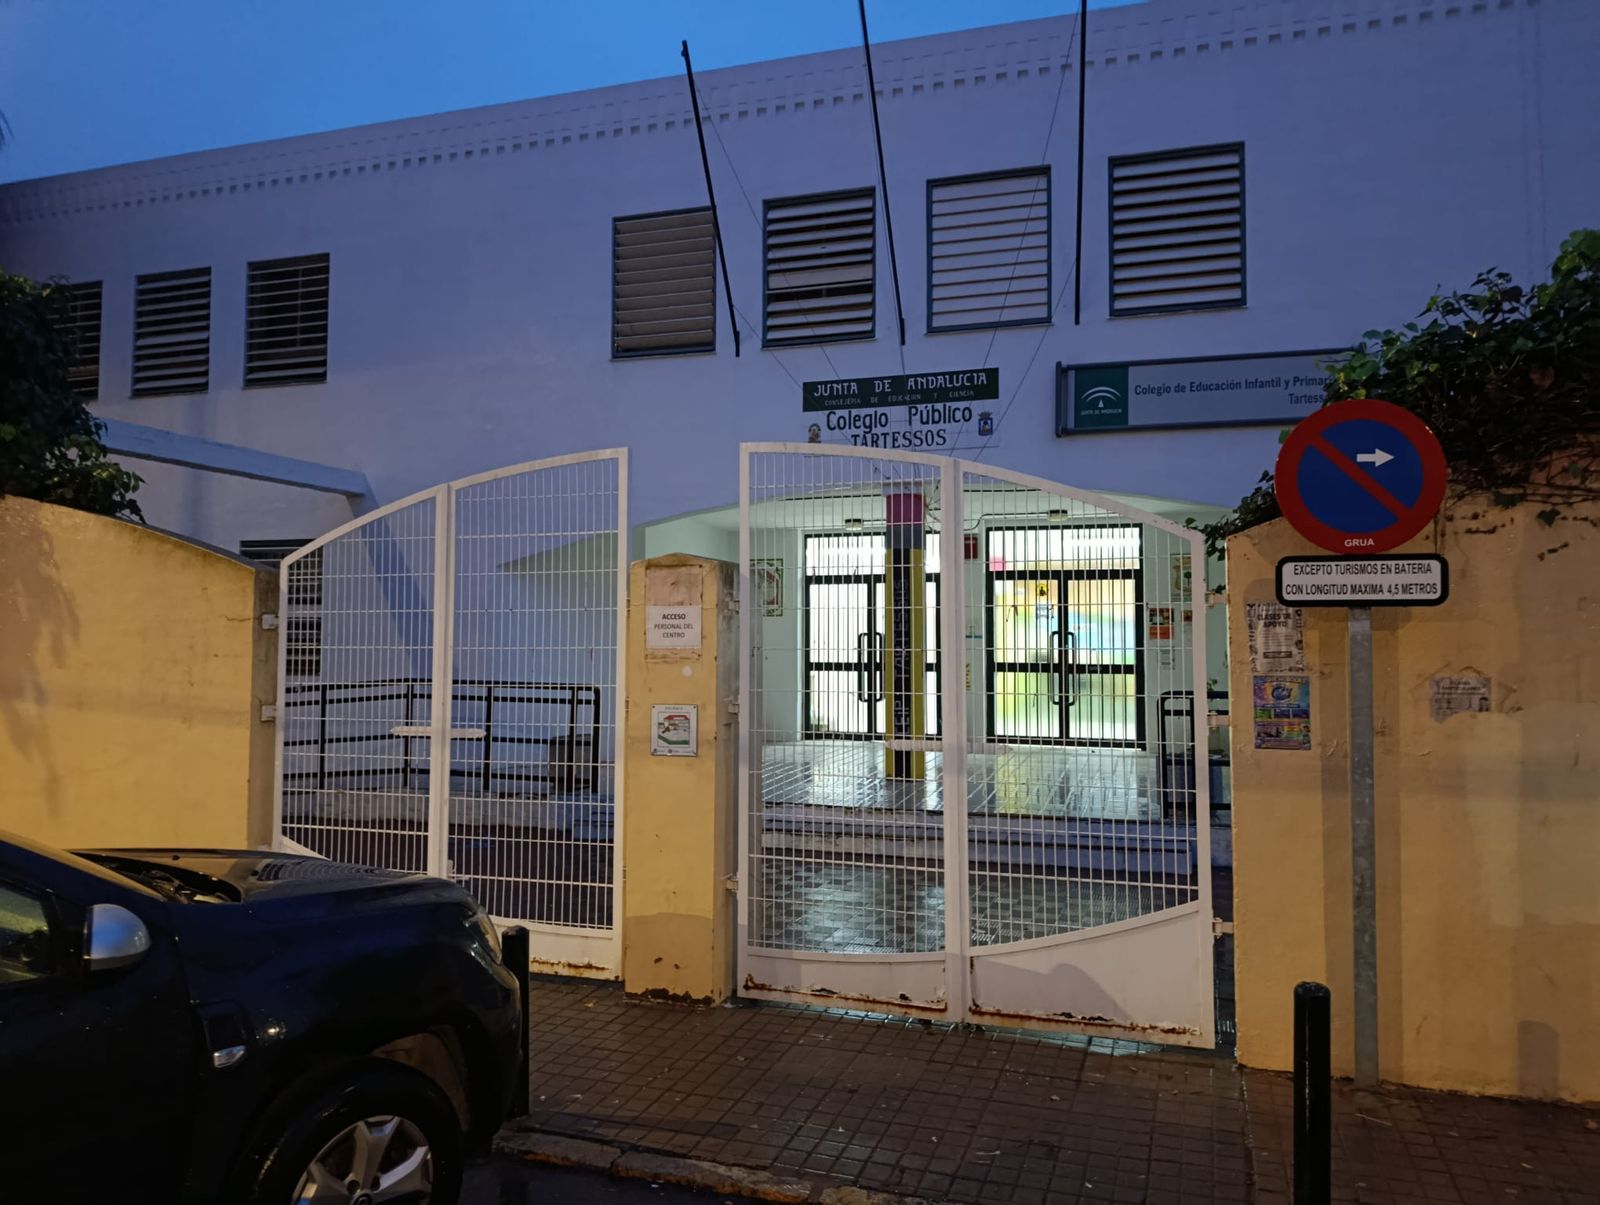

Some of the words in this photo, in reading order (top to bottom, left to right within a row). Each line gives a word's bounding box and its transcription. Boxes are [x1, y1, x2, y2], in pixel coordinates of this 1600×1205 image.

[814, 382, 858, 397] JUNTA
[874, 379, 892, 393] DE
[1134, 384, 1172, 397] Colegio
[1174, 382, 1187, 393] de
[1189, 379, 1242, 393] Educación
[1245, 376, 1281, 389] Infantil
[1283, 379, 1290, 390] y
[1293, 375, 1330, 387] Primar
[1288, 393, 1324, 405] Tartess
[826, 411, 889, 434] Colegio
[908, 404, 973, 427] Público
[851, 429, 947, 449] TARTESSOS
[1344, 537, 1376, 547] GRUA
[1293, 563, 1333, 576] EXCEPTO
[1334, 563, 1379, 575] TURISMOS
[1380, 563, 1393, 575] EN
[1394, 562, 1432, 574] BATERIA
[1285, 583, 1304, 596] CON
[1305, 583, 1348, 596] LONGITUD
[1350, 583, 1384, 595] MAXIMA
[1387, 583, 1399, 597] 4,5
[1401, 582, 1438, 595] METROS
[683, 622, 694, 630] DEL
[662, 631, 686, 639] CENTRO
